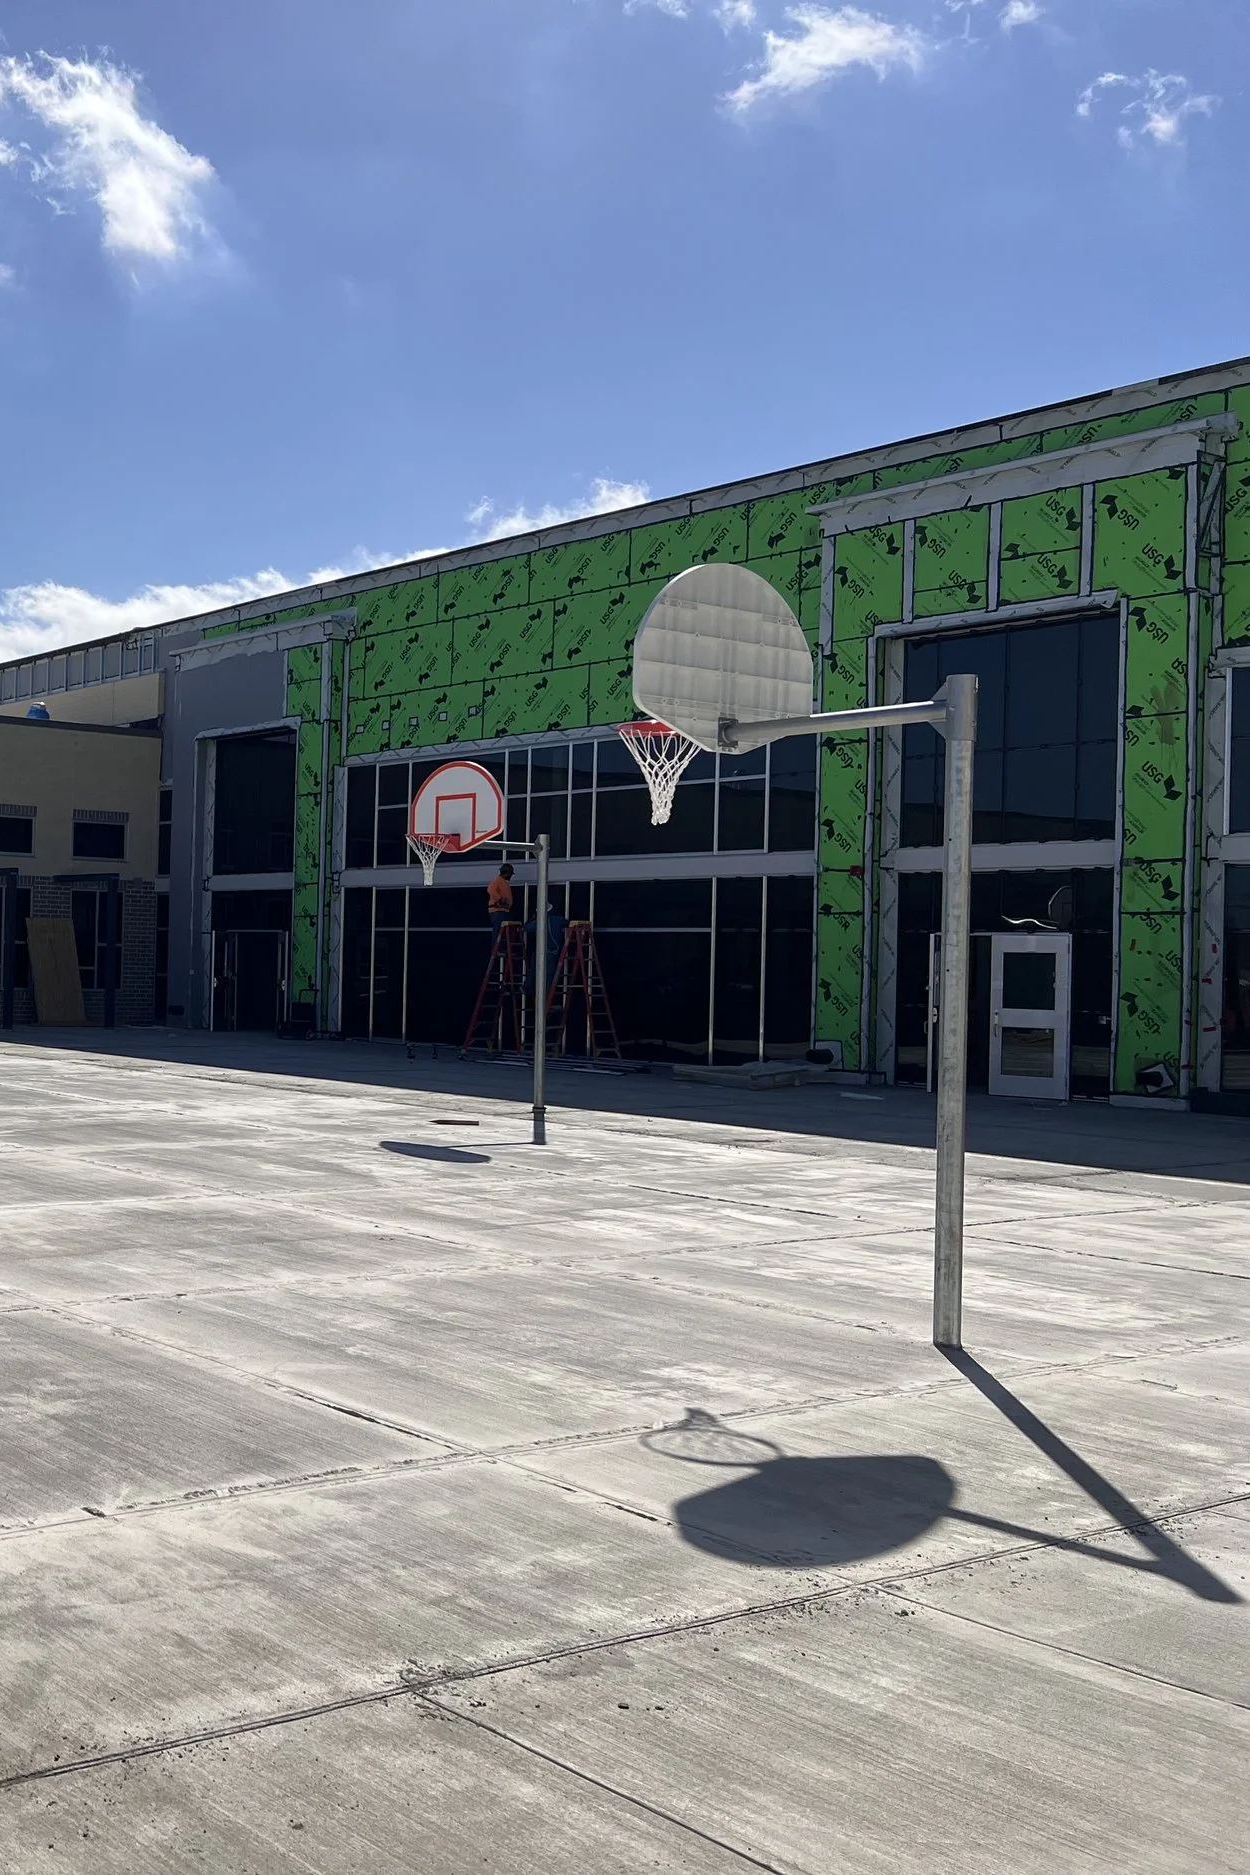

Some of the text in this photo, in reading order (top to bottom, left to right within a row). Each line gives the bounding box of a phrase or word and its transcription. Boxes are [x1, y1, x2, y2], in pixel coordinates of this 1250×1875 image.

[808, 484, 826, 506] USG
[1224, 488, 1248, 515] USG
[740, 502, 756, 520] USG
[1045, 496, 1066, 516] USG
[675, 518, 690, 536] USG
[780, 512, 798, 532] USG
[1118, 509, 1140, 530] USG
[714, 528, 730, 546] USG
[870, 527, 886, 542] USG
[600, 535, 614, 552] USG
[652, 541, 666, 560] USG
[928, 538, 946, 558] USG
[545, 548, 558, 564] USG
[1142, 543, 1164, 566] USG
[472, 564, 484, 580] USG
[578, 558, 592, 575] USG
[1037, 554, 1058, 574] USG
[387, 583, 398, 600] USG
[500, 574, 514, 592] USG
[848, 578, 864, 598] USG
[414, 594, 425, 610] USG
[452, 585, 464, 602] USG
[370, 604, 380, 619] USG
[600, 607, 614, 624] USG
[520, 622, 532, 638] USG
[577, 629, 591, 646] USG
[1146, 622, 1169, 644] USG
[469, 632, 482, 648] USG
[400, 645, 411, 660] USG
[498, 643, 512, 660] USG
[382, 664, 393, 680] USG
[426, 656, 438, 672] USG
[1171, 657, 1188, 680] US
[838, 666, 854, 684] USG
[579, 688, 590, 700] US
[608, 679, 622, 696] USG
[525, 691, 538, 707] USG
[589, 700, 598, 712] US
[428, 704, 439, 720] USG
[504, 711, 518, 728] USG
[557, 704, 570, 720] USG
[455, 718, 468, 734] USG
[1125, 730, 1140, 746] US
[836, 747, 854, 768] USG
[1142, 760, 1164, 784] USG
[854, 779, 867, 796] US
[834, 832, 852, 853] USG
[1124, 828, 1137, 846] US
[1138, 862, 1162, 884] USG
[852, 944, 862, 959] US
[832, 995, 848, 1016] USG
[1138, 1010, 1161, 1036] USG
[850, 1030, 860, 1046] US
[1164, 1050, 1179, 1069] US
